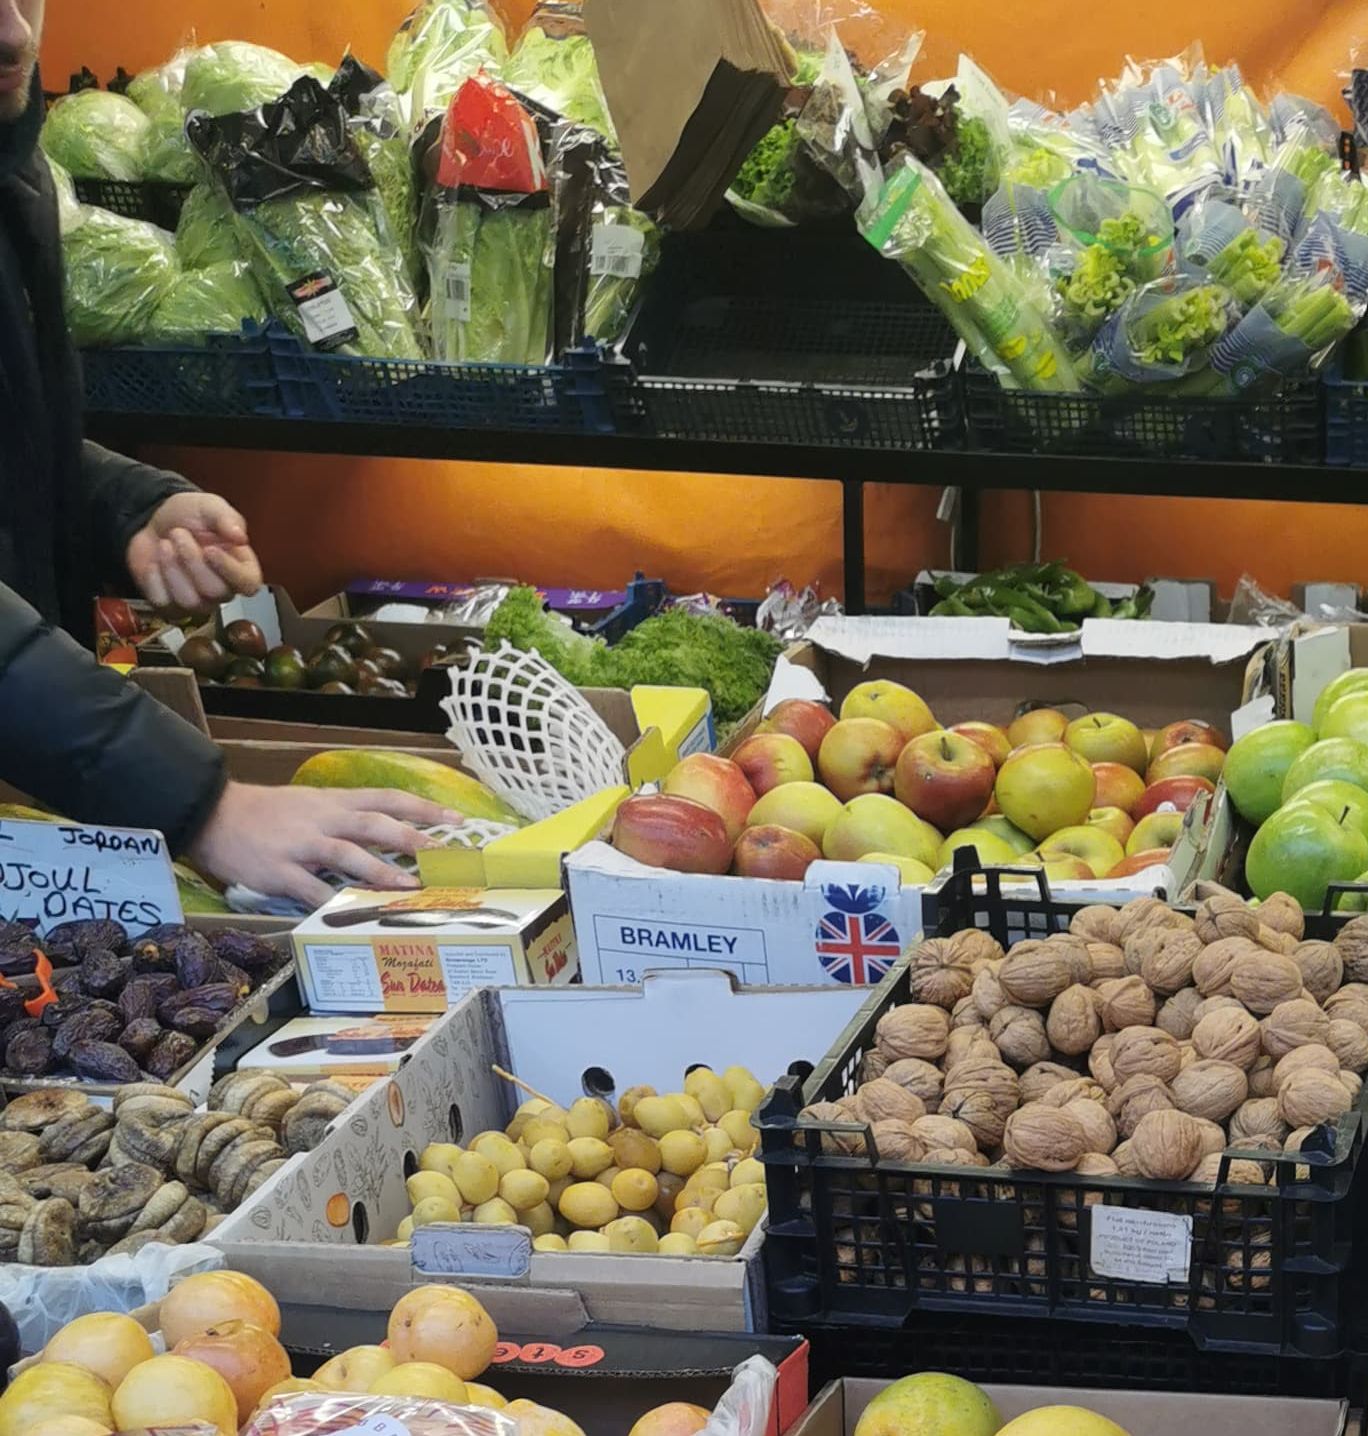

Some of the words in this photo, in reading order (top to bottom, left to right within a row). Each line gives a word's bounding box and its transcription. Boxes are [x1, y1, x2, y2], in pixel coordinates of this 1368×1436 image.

[58, 827, 160, 855] JORDAN
[44, 891, 162, 926] DATES
[378, 944, 435, 956] MATINA
[620, 926, 738, 954] BRAMLEY
